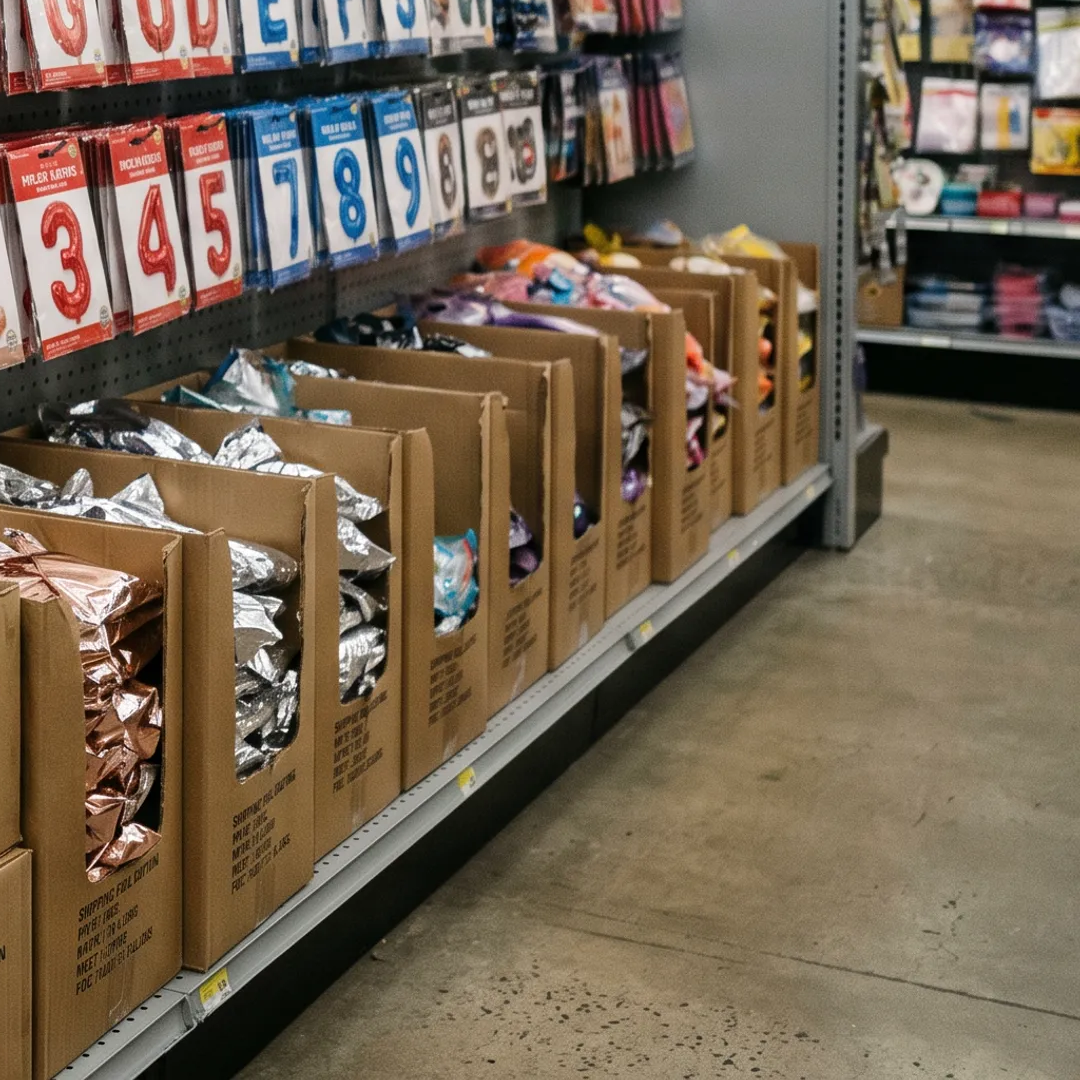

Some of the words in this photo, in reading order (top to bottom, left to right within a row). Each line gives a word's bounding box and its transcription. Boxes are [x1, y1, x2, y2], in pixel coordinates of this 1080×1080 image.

[199, 169, 232, 278] 5
[272, 156, 299, 260] 7
[333, 147, 367, 243] 8
[395, 136, 422, 229] 9
[41, 200, 92, 324] 3
[138, 184, 176, 296] 4
